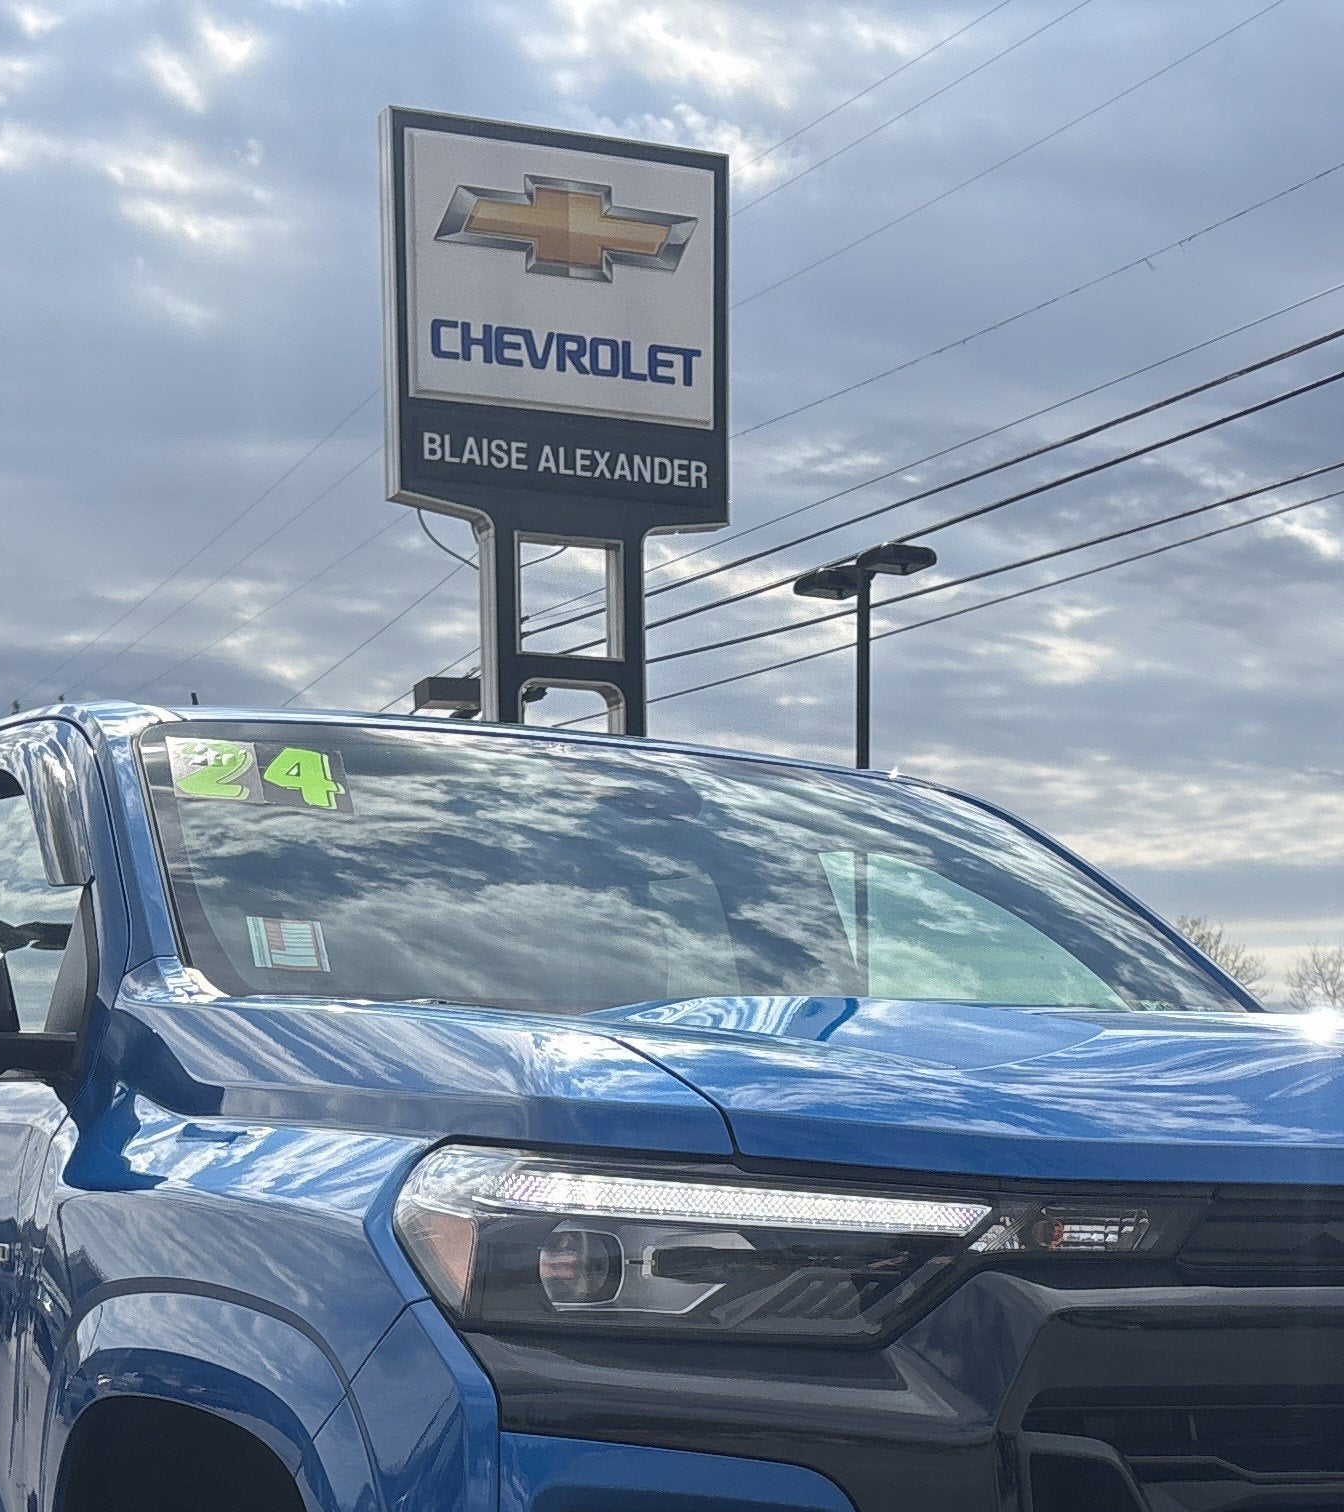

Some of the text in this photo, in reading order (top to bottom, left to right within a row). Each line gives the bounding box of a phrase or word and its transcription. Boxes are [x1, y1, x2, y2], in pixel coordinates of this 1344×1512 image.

[430, 318, 702, 387] CHEVROLET
[422, 431, 709, 490] BLAISE ALEXANDER
